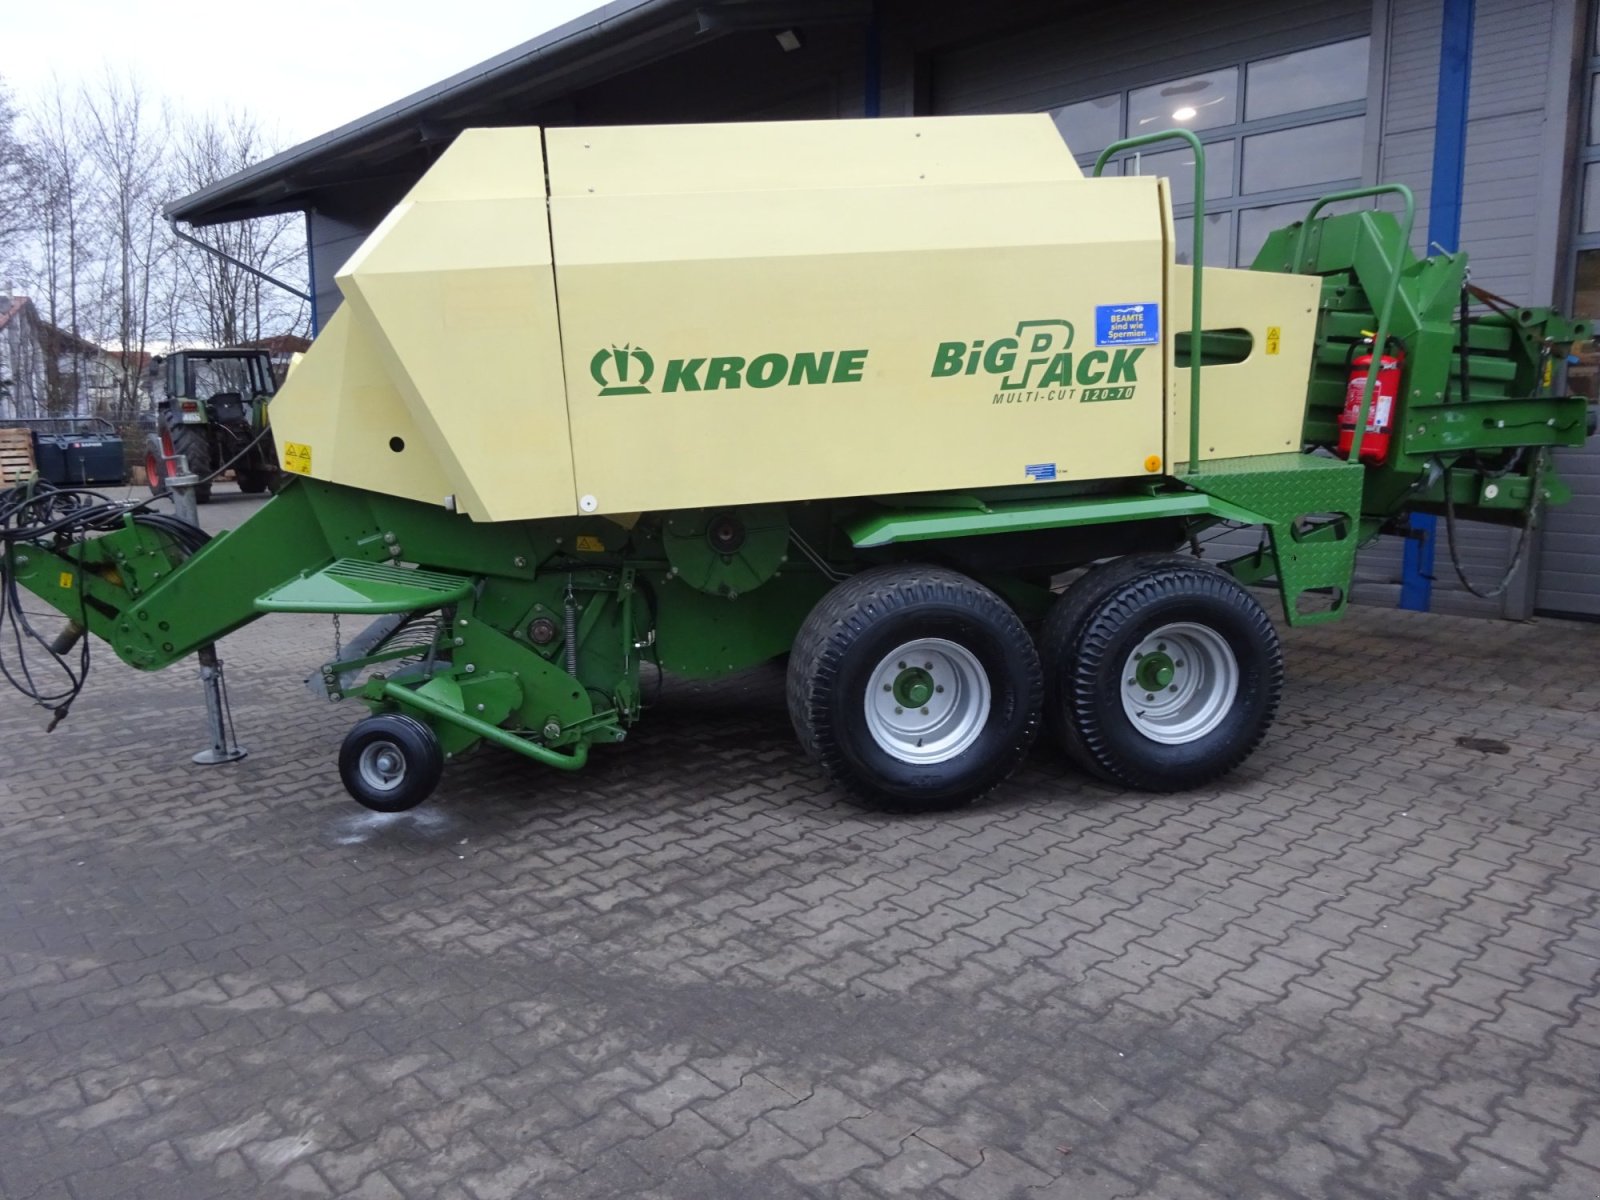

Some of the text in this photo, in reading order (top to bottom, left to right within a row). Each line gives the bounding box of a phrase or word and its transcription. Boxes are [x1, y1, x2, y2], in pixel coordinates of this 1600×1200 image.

[1110, 313, 1144, 323] BEAMTE
[1111, 322, 1144, 331] sind wie
[1108, 330, 1147, 340] Spermien
[1000, 319, 1146, 389] PACK
[661, 349, 869, 393] KRONE
[992, 387, 1134, 405] MULTI-CUT 120-70
